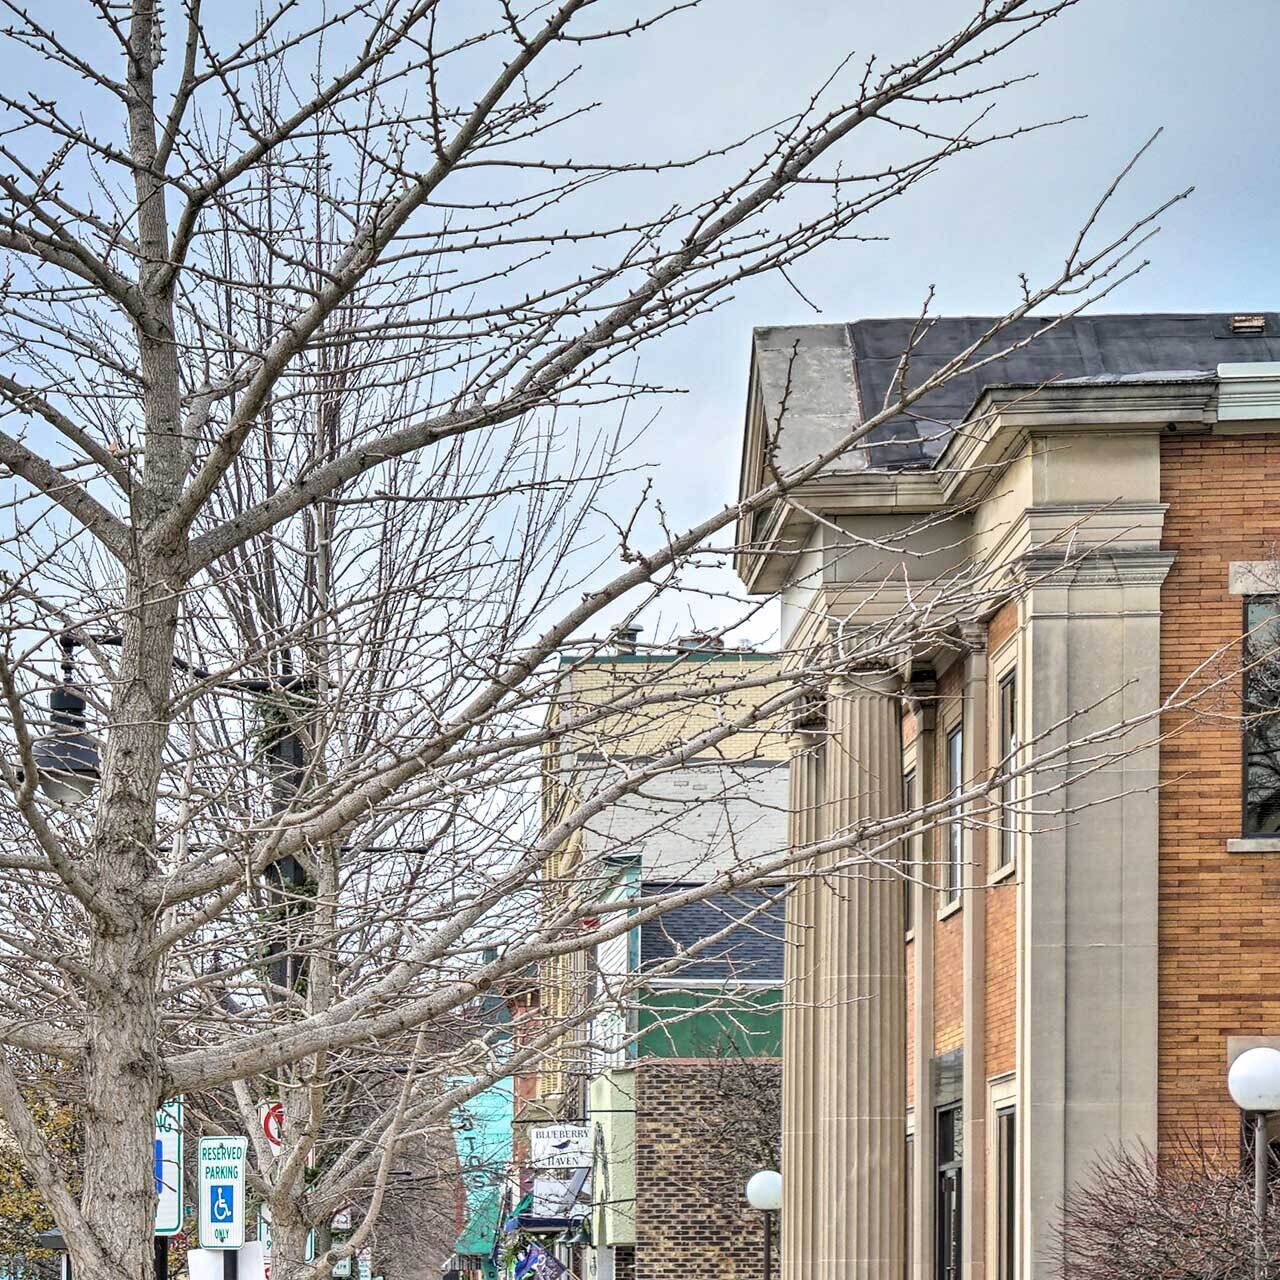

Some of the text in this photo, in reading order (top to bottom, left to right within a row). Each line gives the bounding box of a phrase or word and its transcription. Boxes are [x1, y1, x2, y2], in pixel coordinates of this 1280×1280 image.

[535, 1130, 589, 1139] BLUEBERRY
[202, 1146, 242, 1160] RESERVED
[547, 1157, 579, 1166] HAVEN
[205, 1165, 239, 1179] PARKING
[214, 1229, 229, 1239] ONLY
